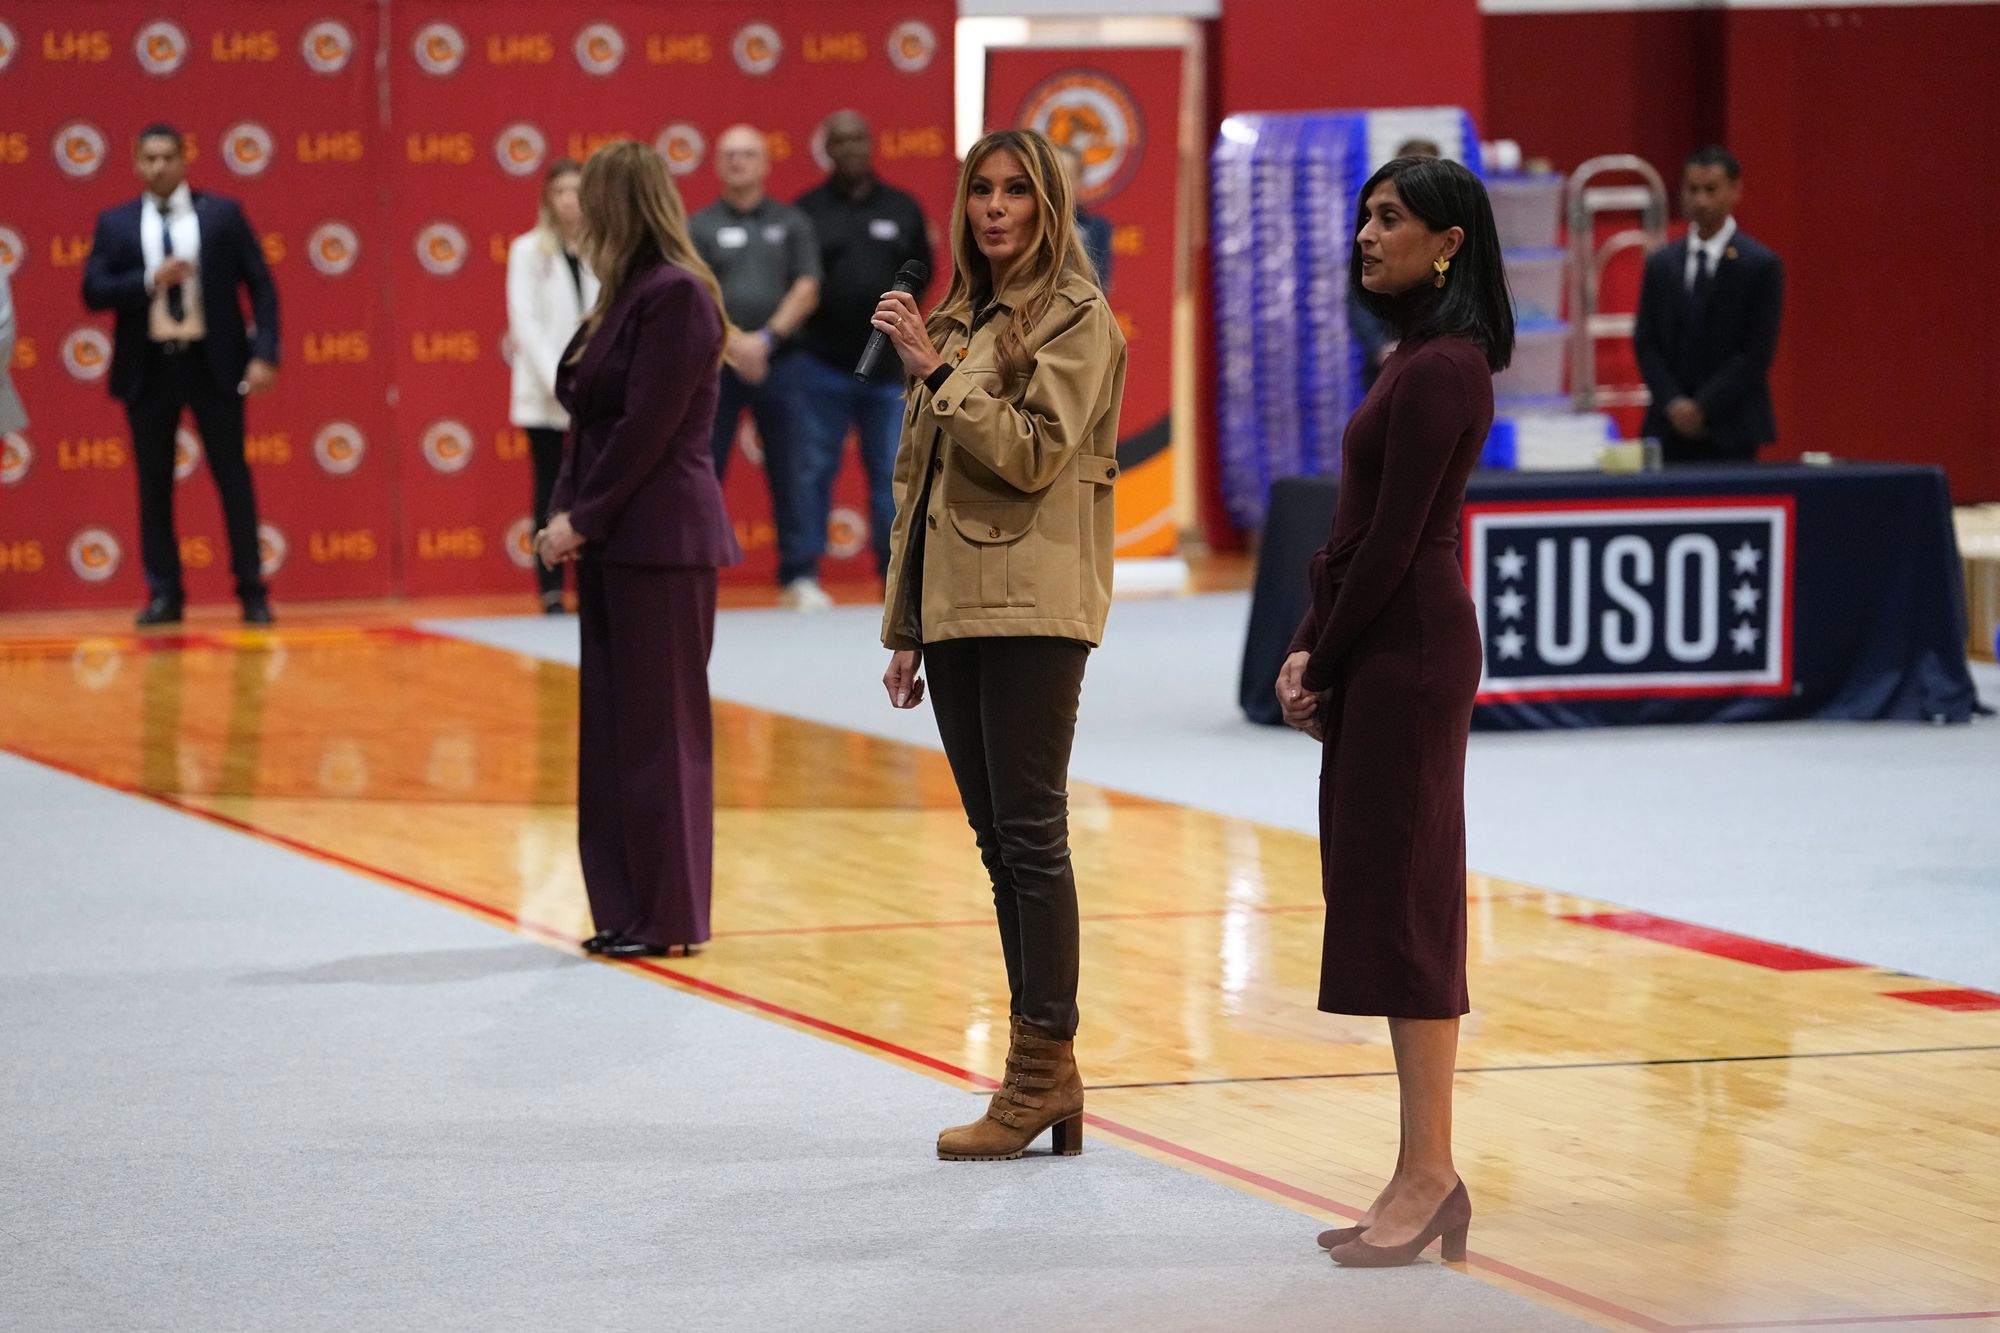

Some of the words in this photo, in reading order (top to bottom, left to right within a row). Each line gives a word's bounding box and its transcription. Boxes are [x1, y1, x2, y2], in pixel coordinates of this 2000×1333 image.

[42, 31, 111, 62] LHS
[211, 30, 279, 62] LHS
[487, 33, 554, 64] LHS
[646, 34, 712, 64] LHS
[803, 32, 867, 62] LHS
[297, 131, 364, 163] LHS
[407, 133, 475, 164] LHS
[880, 127, 945, 159] LHS
[303, 330, 370, 364] LHS
[412, 330, 481, 363] LHS
[58, 437, 127, 470] LHS
[309, 529, 377, 561] LHS
[417, 527, 486, 560] LHS
[1536, 533, 1720, 666] USO
